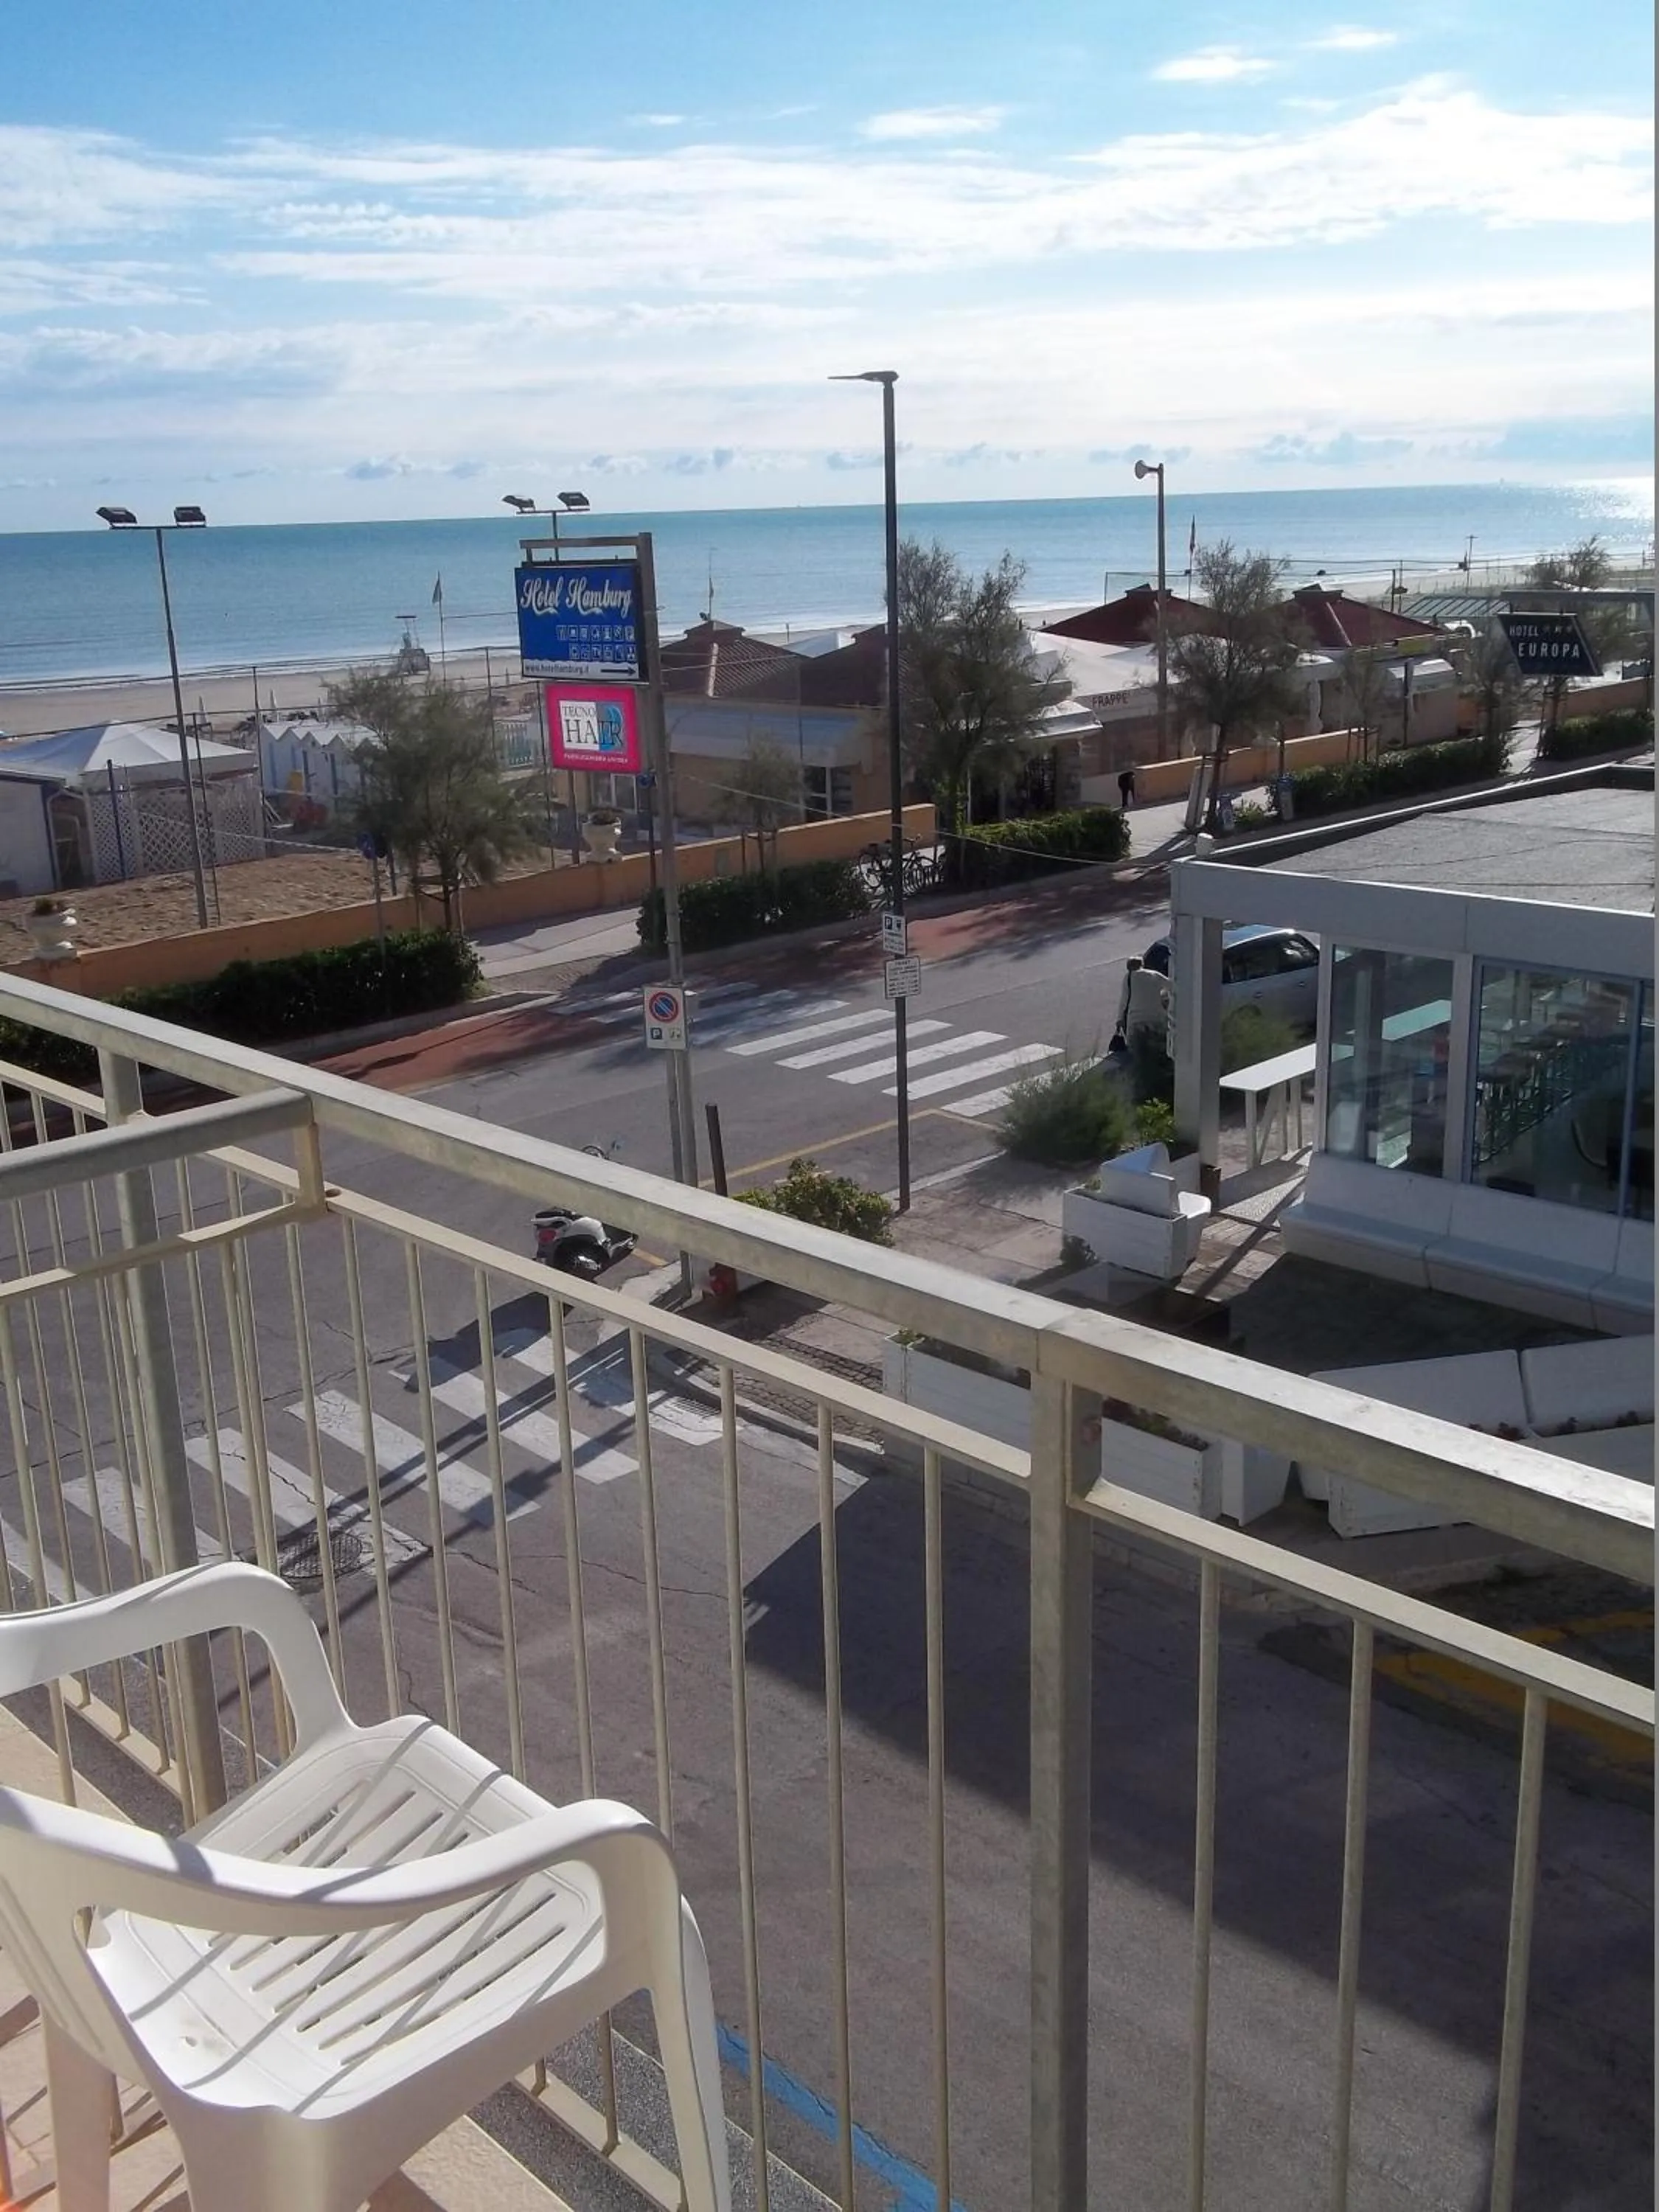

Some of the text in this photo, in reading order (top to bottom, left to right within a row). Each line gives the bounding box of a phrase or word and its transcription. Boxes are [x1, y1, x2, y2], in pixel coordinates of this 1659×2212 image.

[521, 576, 633, 619] Hotel Hamburg
[1509, 625, 1539, 636] HOTEL
[1518, 642, 1579, 658] EUROPA
[565, 719, 624, 746] HAIR
